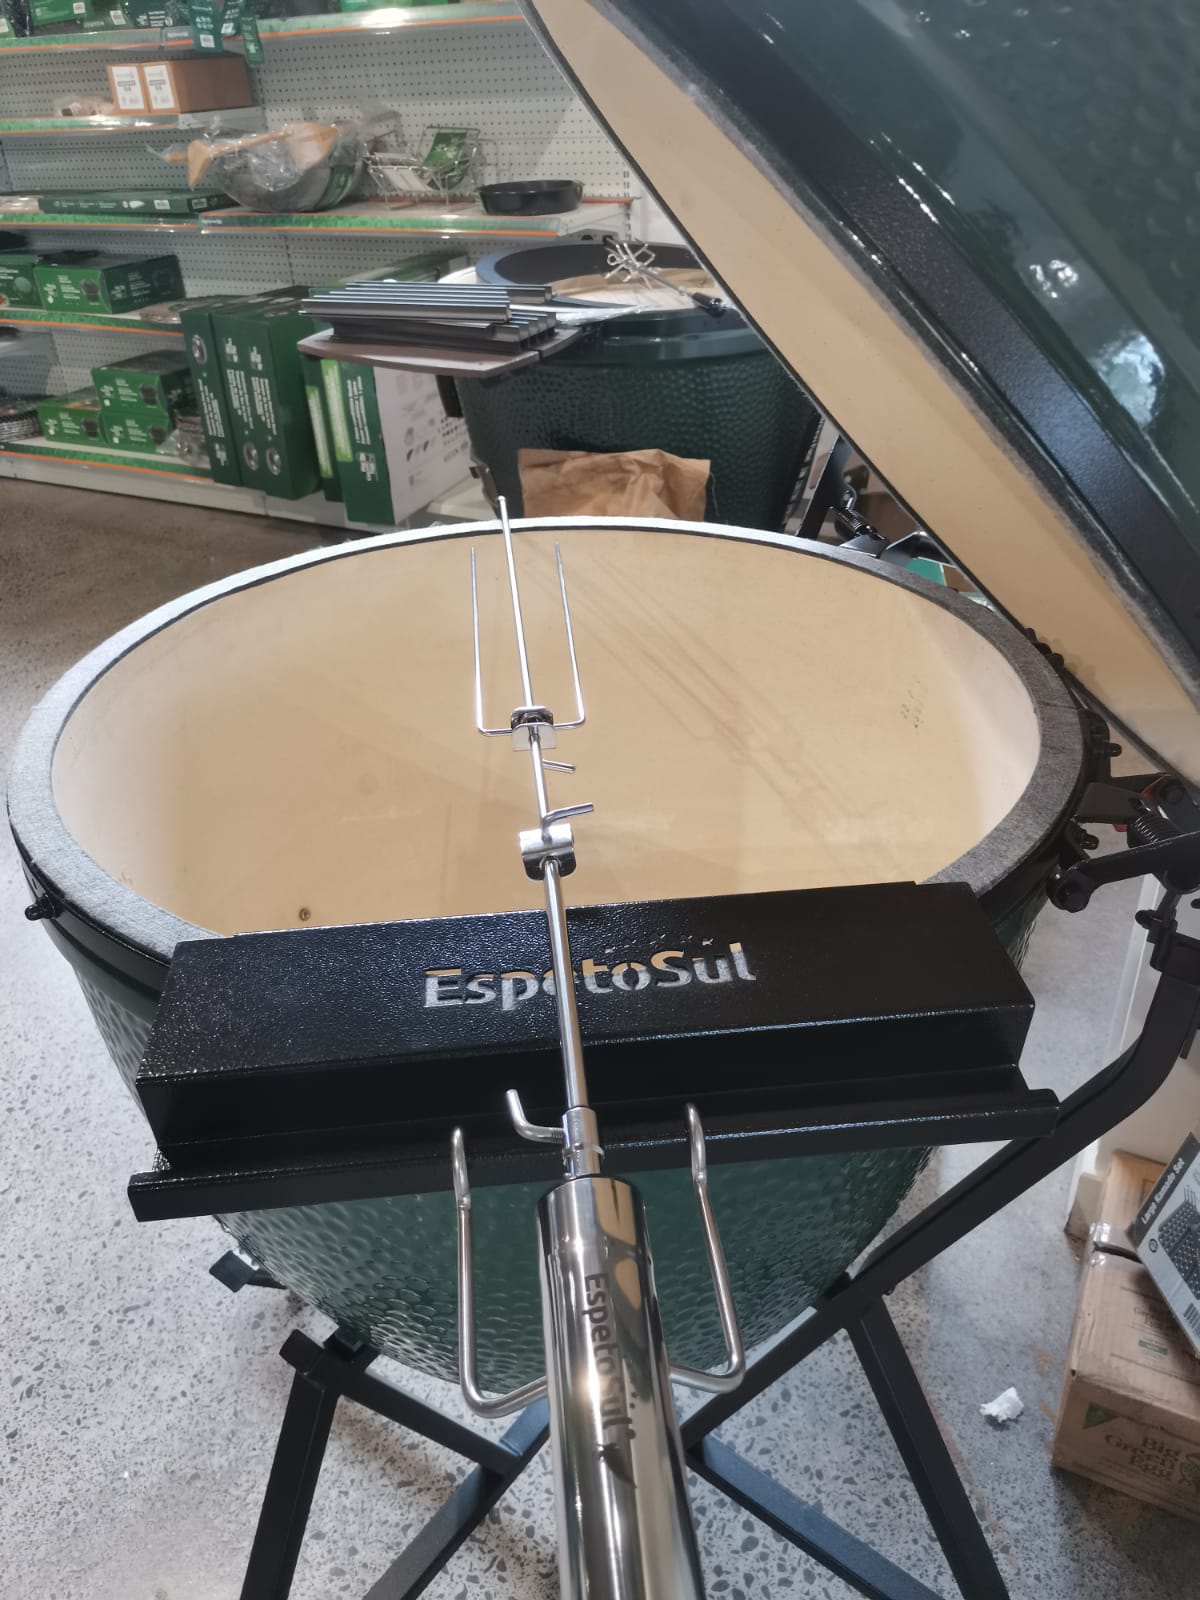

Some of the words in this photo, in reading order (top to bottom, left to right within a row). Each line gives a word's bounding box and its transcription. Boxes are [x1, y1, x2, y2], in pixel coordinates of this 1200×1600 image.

[1141, 1201, 1157, 1224] Large
[1154, 1172, 1176, 1204] Kamado
[1173, 1157, 1185, 1174] Set
[1105, 1434, 1176, 1470] Green
[1143, 1436, 1181, 1462] Big
[1130, 1455, 1173, 1481] Egg
